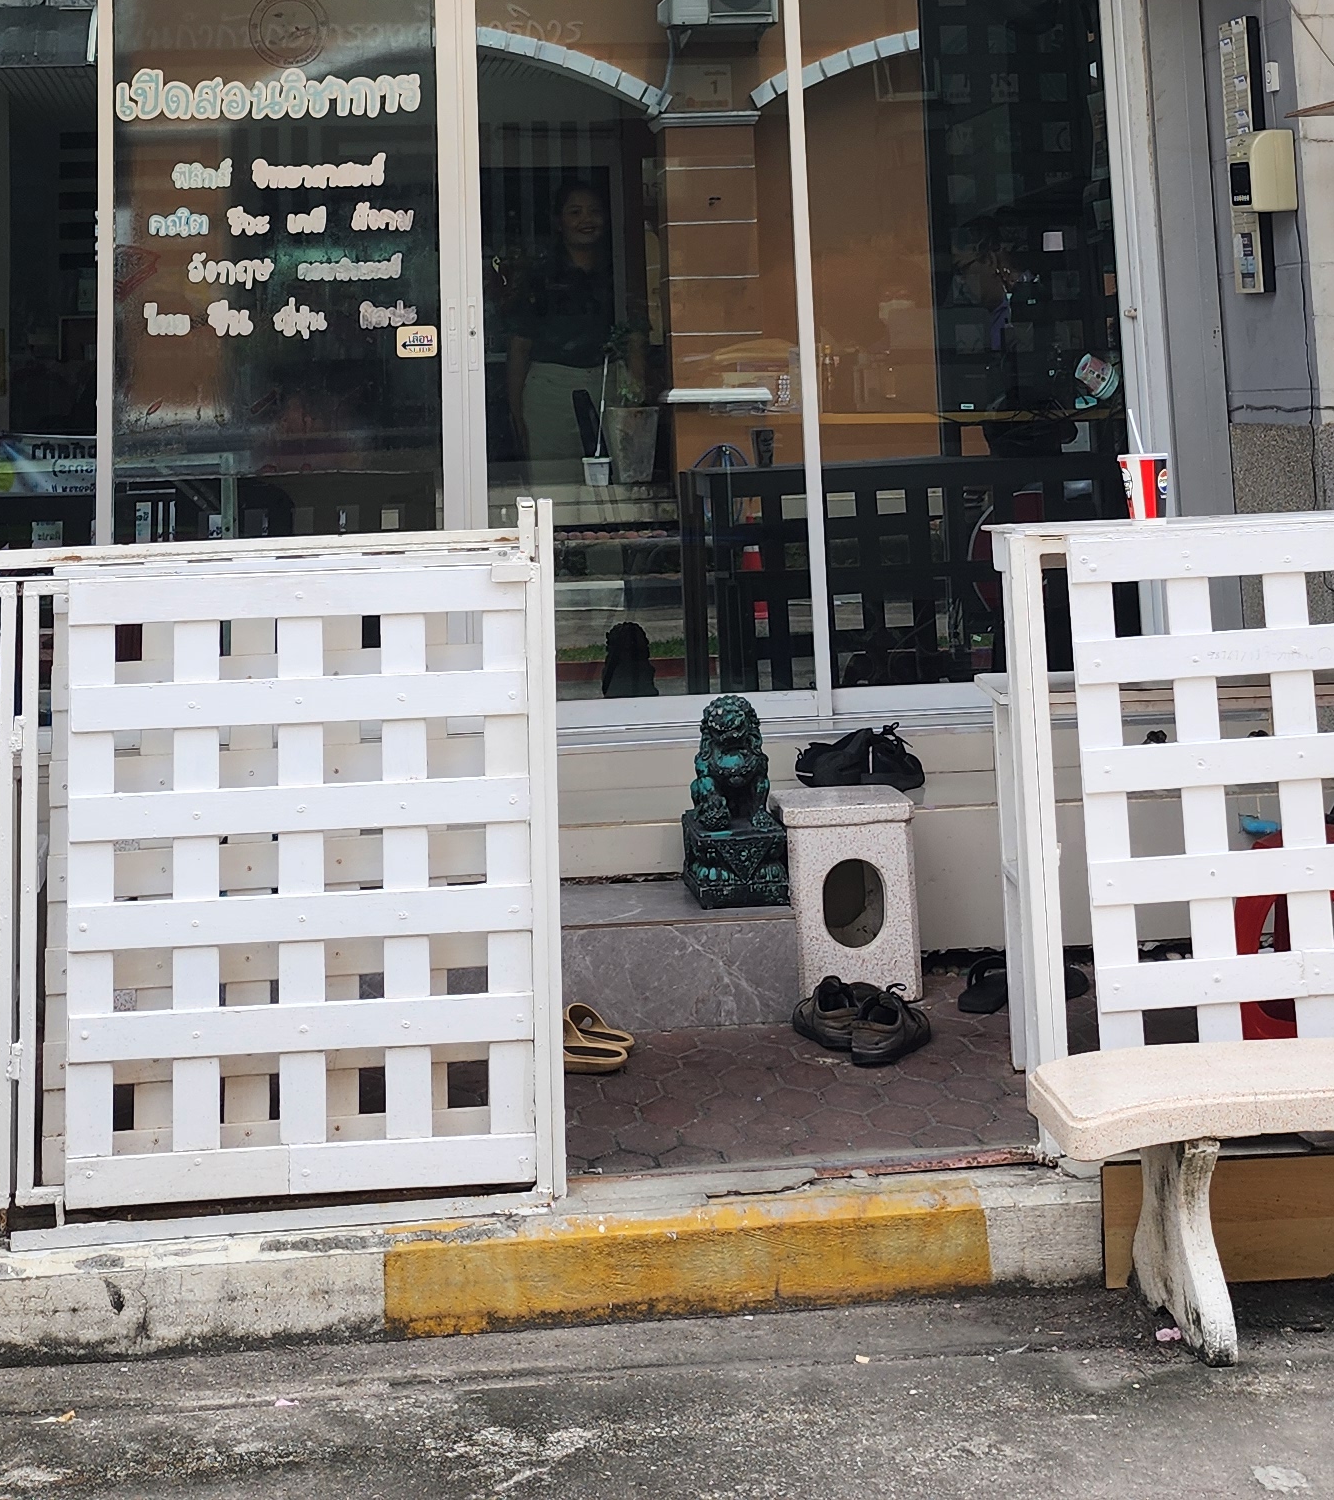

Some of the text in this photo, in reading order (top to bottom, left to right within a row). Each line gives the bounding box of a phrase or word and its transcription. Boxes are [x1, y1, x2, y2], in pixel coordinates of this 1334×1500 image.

[115, 68, 421, 121] เปิดสอนวิชาการ
[171, 158, 233, 189] ฟิสิกส์
[148, 207, 209, 237] คณิต
[187, 252, 274, 290] อังกฤษ
